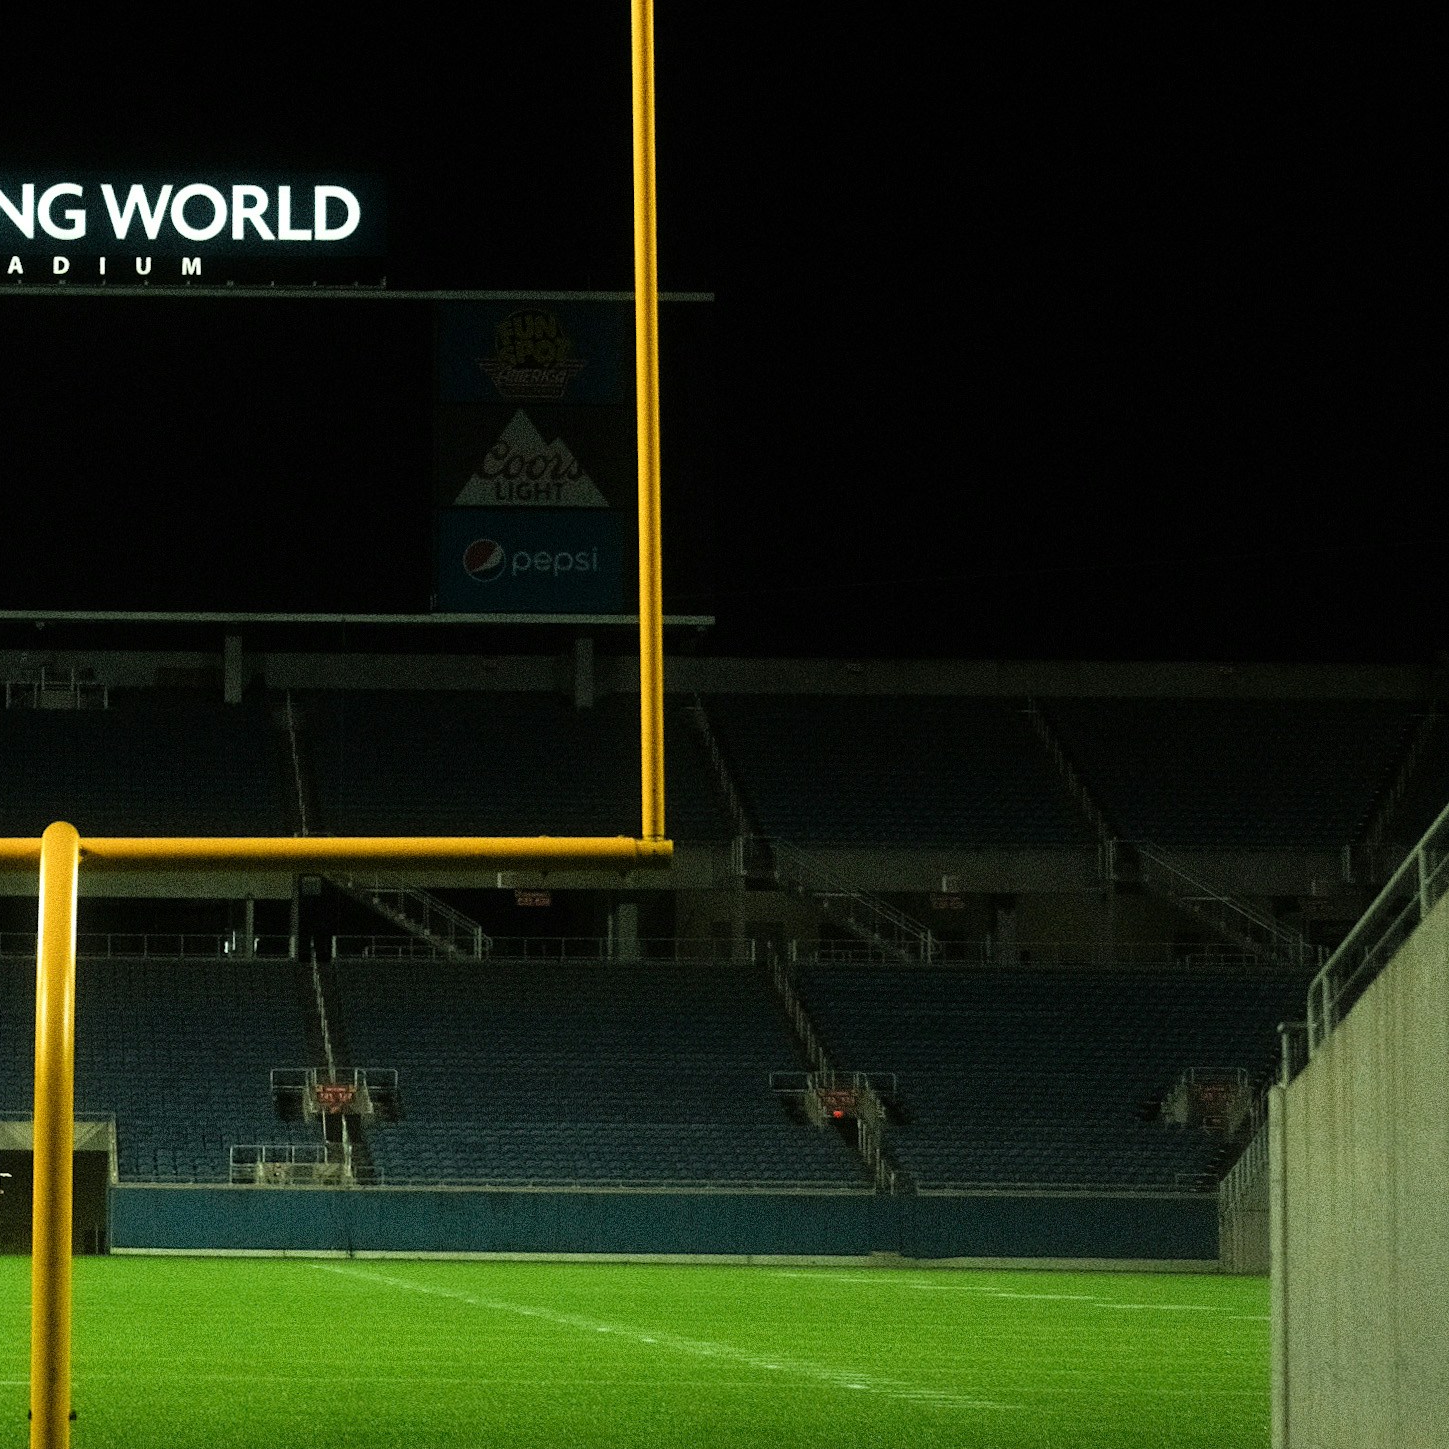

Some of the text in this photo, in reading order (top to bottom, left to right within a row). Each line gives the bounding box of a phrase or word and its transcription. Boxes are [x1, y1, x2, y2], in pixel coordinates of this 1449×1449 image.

[100, 183, 362, 242] WORLD
[496, 313, 559, 345] FUN
[498, 338, 570, 364] SPOT
[473, 439, 583, 480] Coors
[494, 482, 564, 501] LIGHT
[511, 545, 599, 575] pepsi
